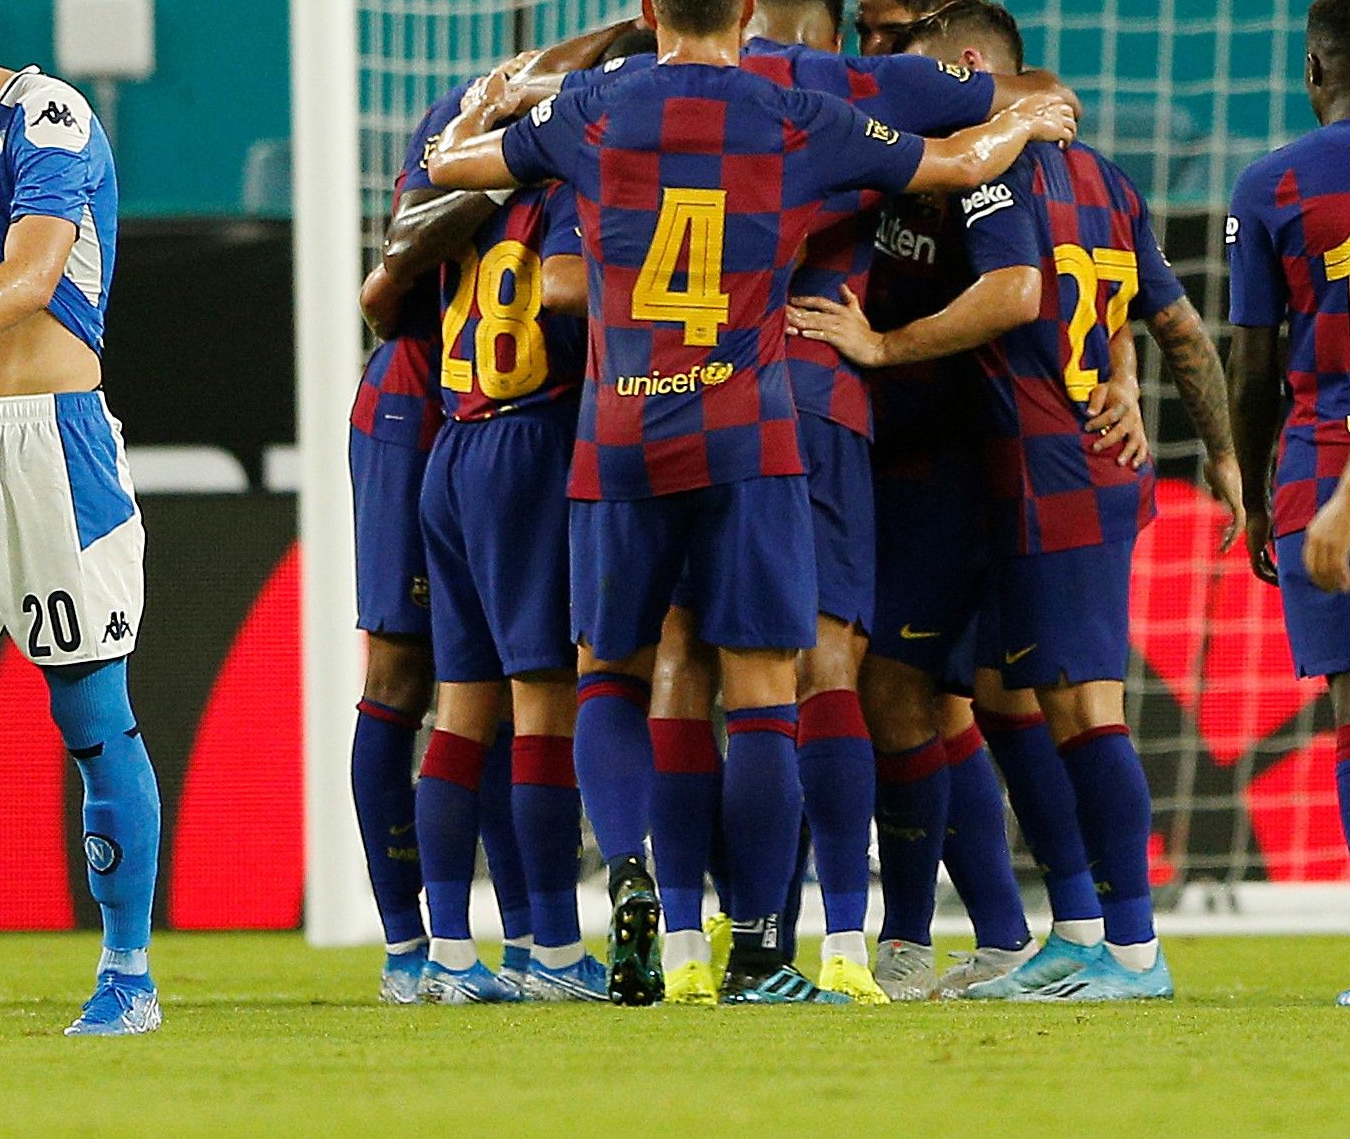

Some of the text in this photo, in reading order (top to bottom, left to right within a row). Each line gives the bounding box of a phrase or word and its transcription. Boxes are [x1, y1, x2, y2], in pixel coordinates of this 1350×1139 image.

[441, 240, 549, 400] 28
[631, 187, 730, 347] 4
[1053, 243, 1140, 402] 27
[616, 364, 701, 396] unicef
[22, 590, 82, 658] 20
